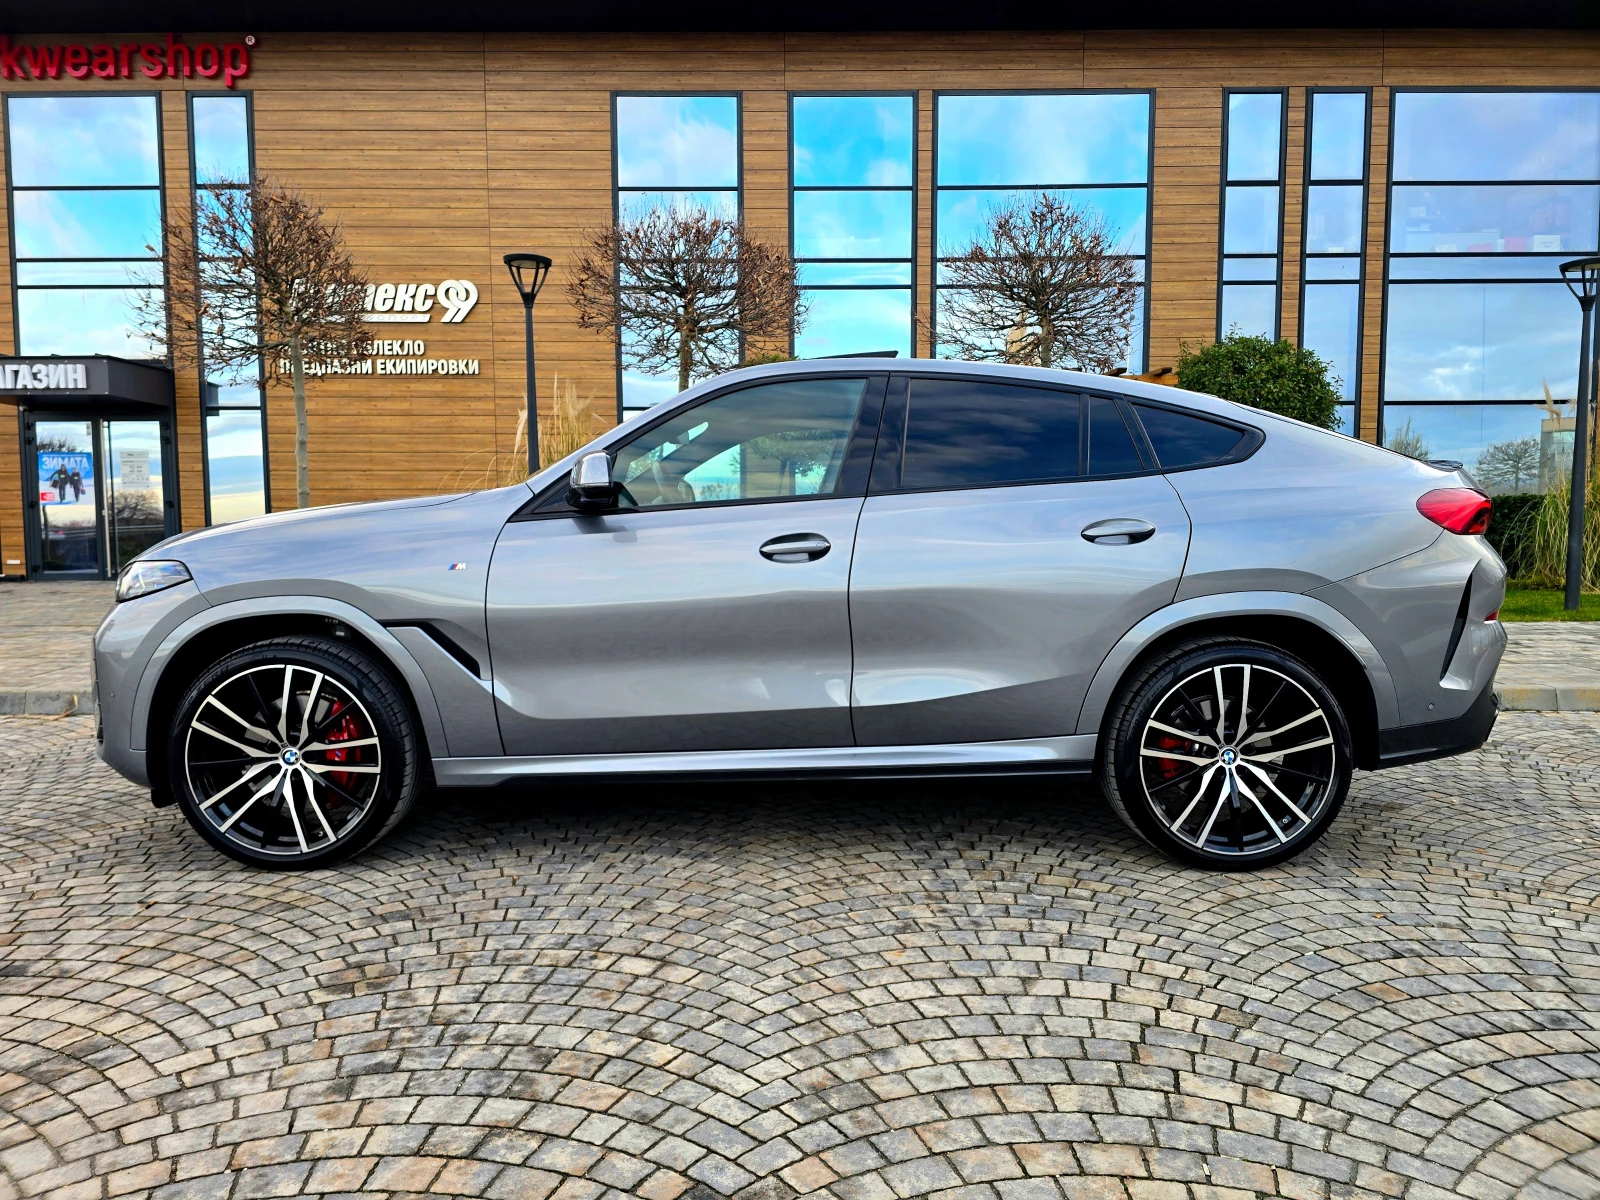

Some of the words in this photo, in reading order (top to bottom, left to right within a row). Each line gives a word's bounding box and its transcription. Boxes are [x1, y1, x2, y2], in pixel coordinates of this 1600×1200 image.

[376, 359, 480, 375] ЕКИПИРОВКИ
[0, 363, 87, 389] ГАЗИН
[41, 456, 89, 470] ЗИМАТА
